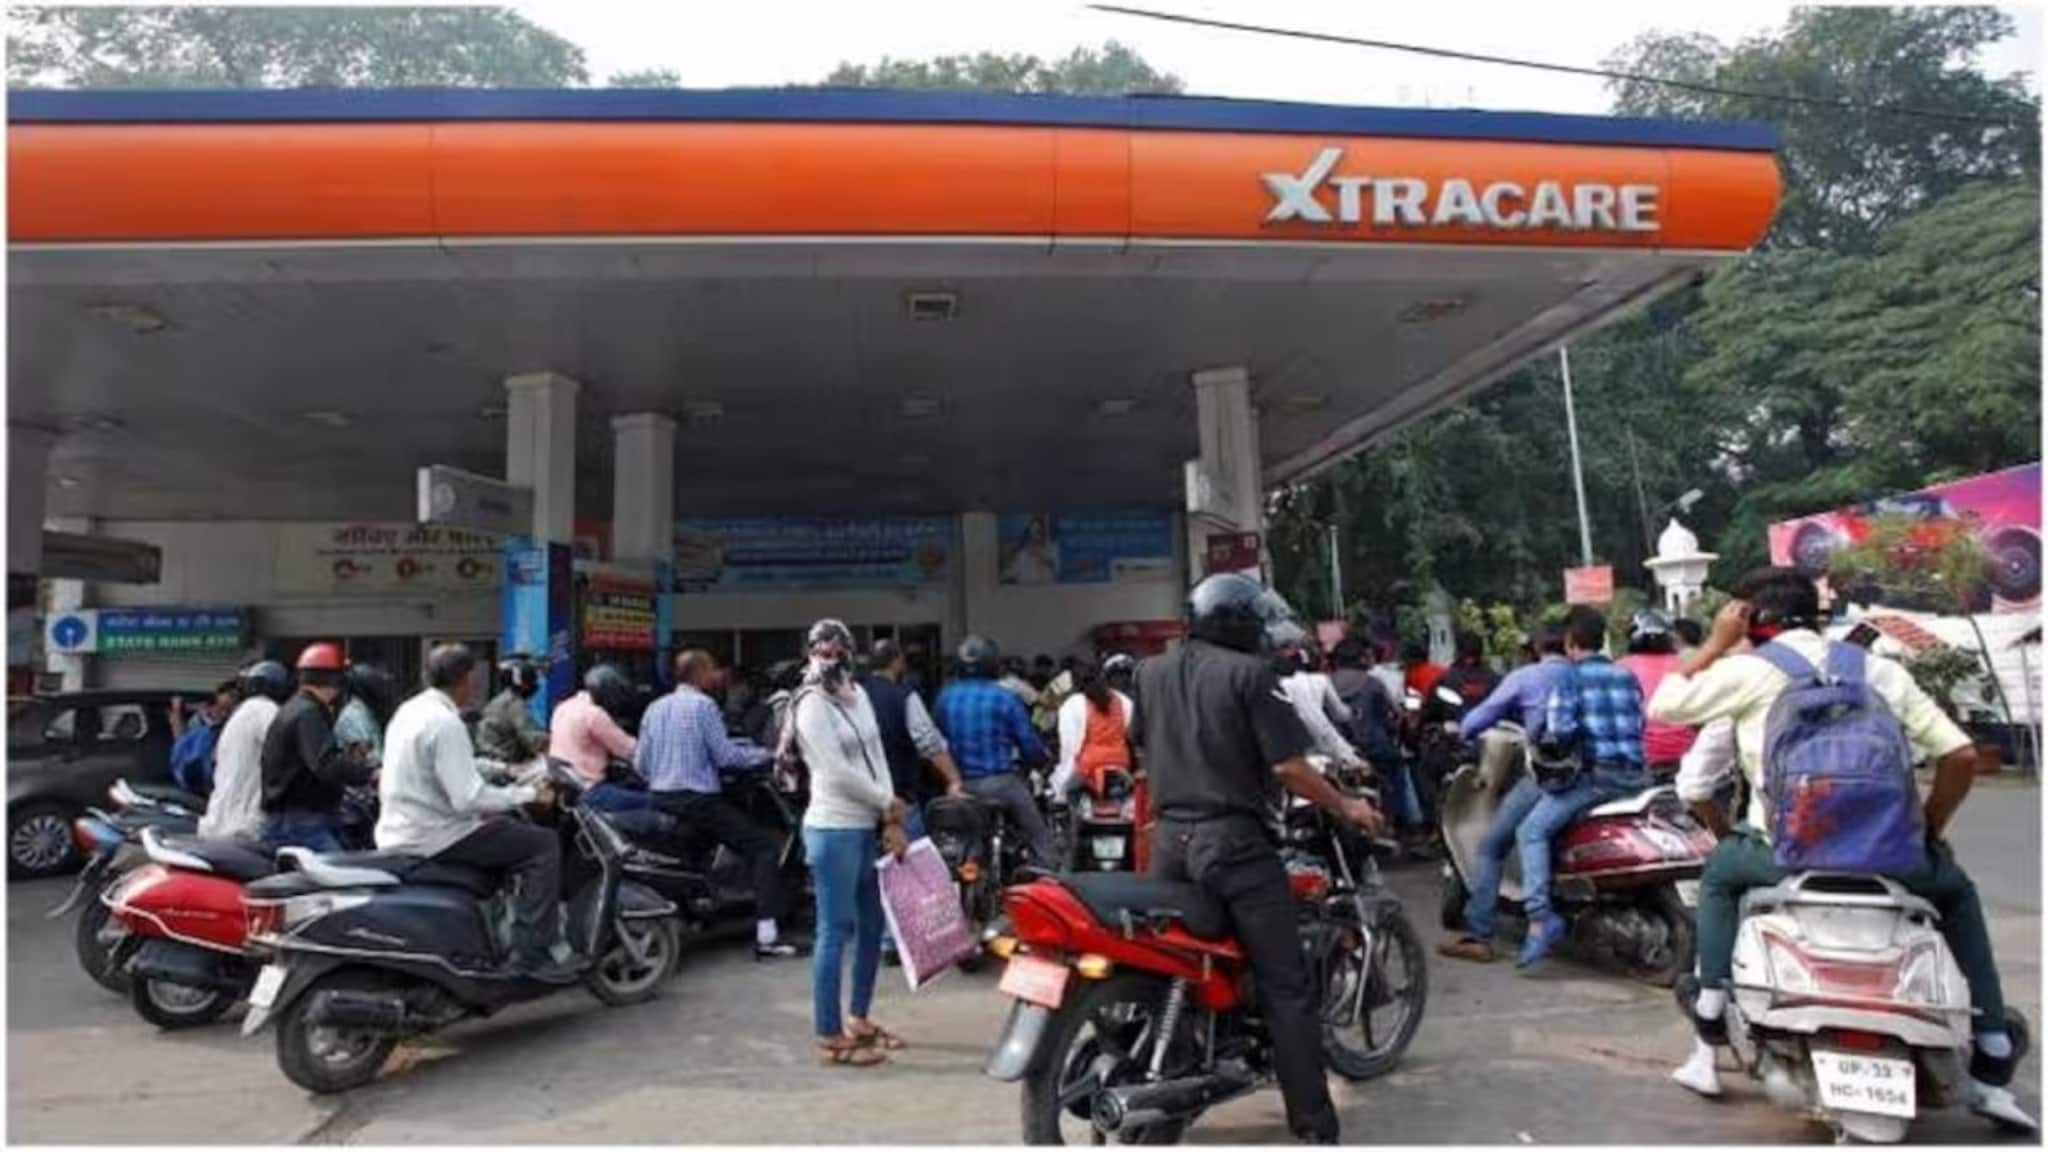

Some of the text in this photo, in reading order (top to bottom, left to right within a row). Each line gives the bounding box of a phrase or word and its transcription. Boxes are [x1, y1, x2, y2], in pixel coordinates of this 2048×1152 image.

[1261, 147, 1660, 232] XTRACARE
[105, 635, 155, 649] STATE
[158, 635, 203, 649] BANK
